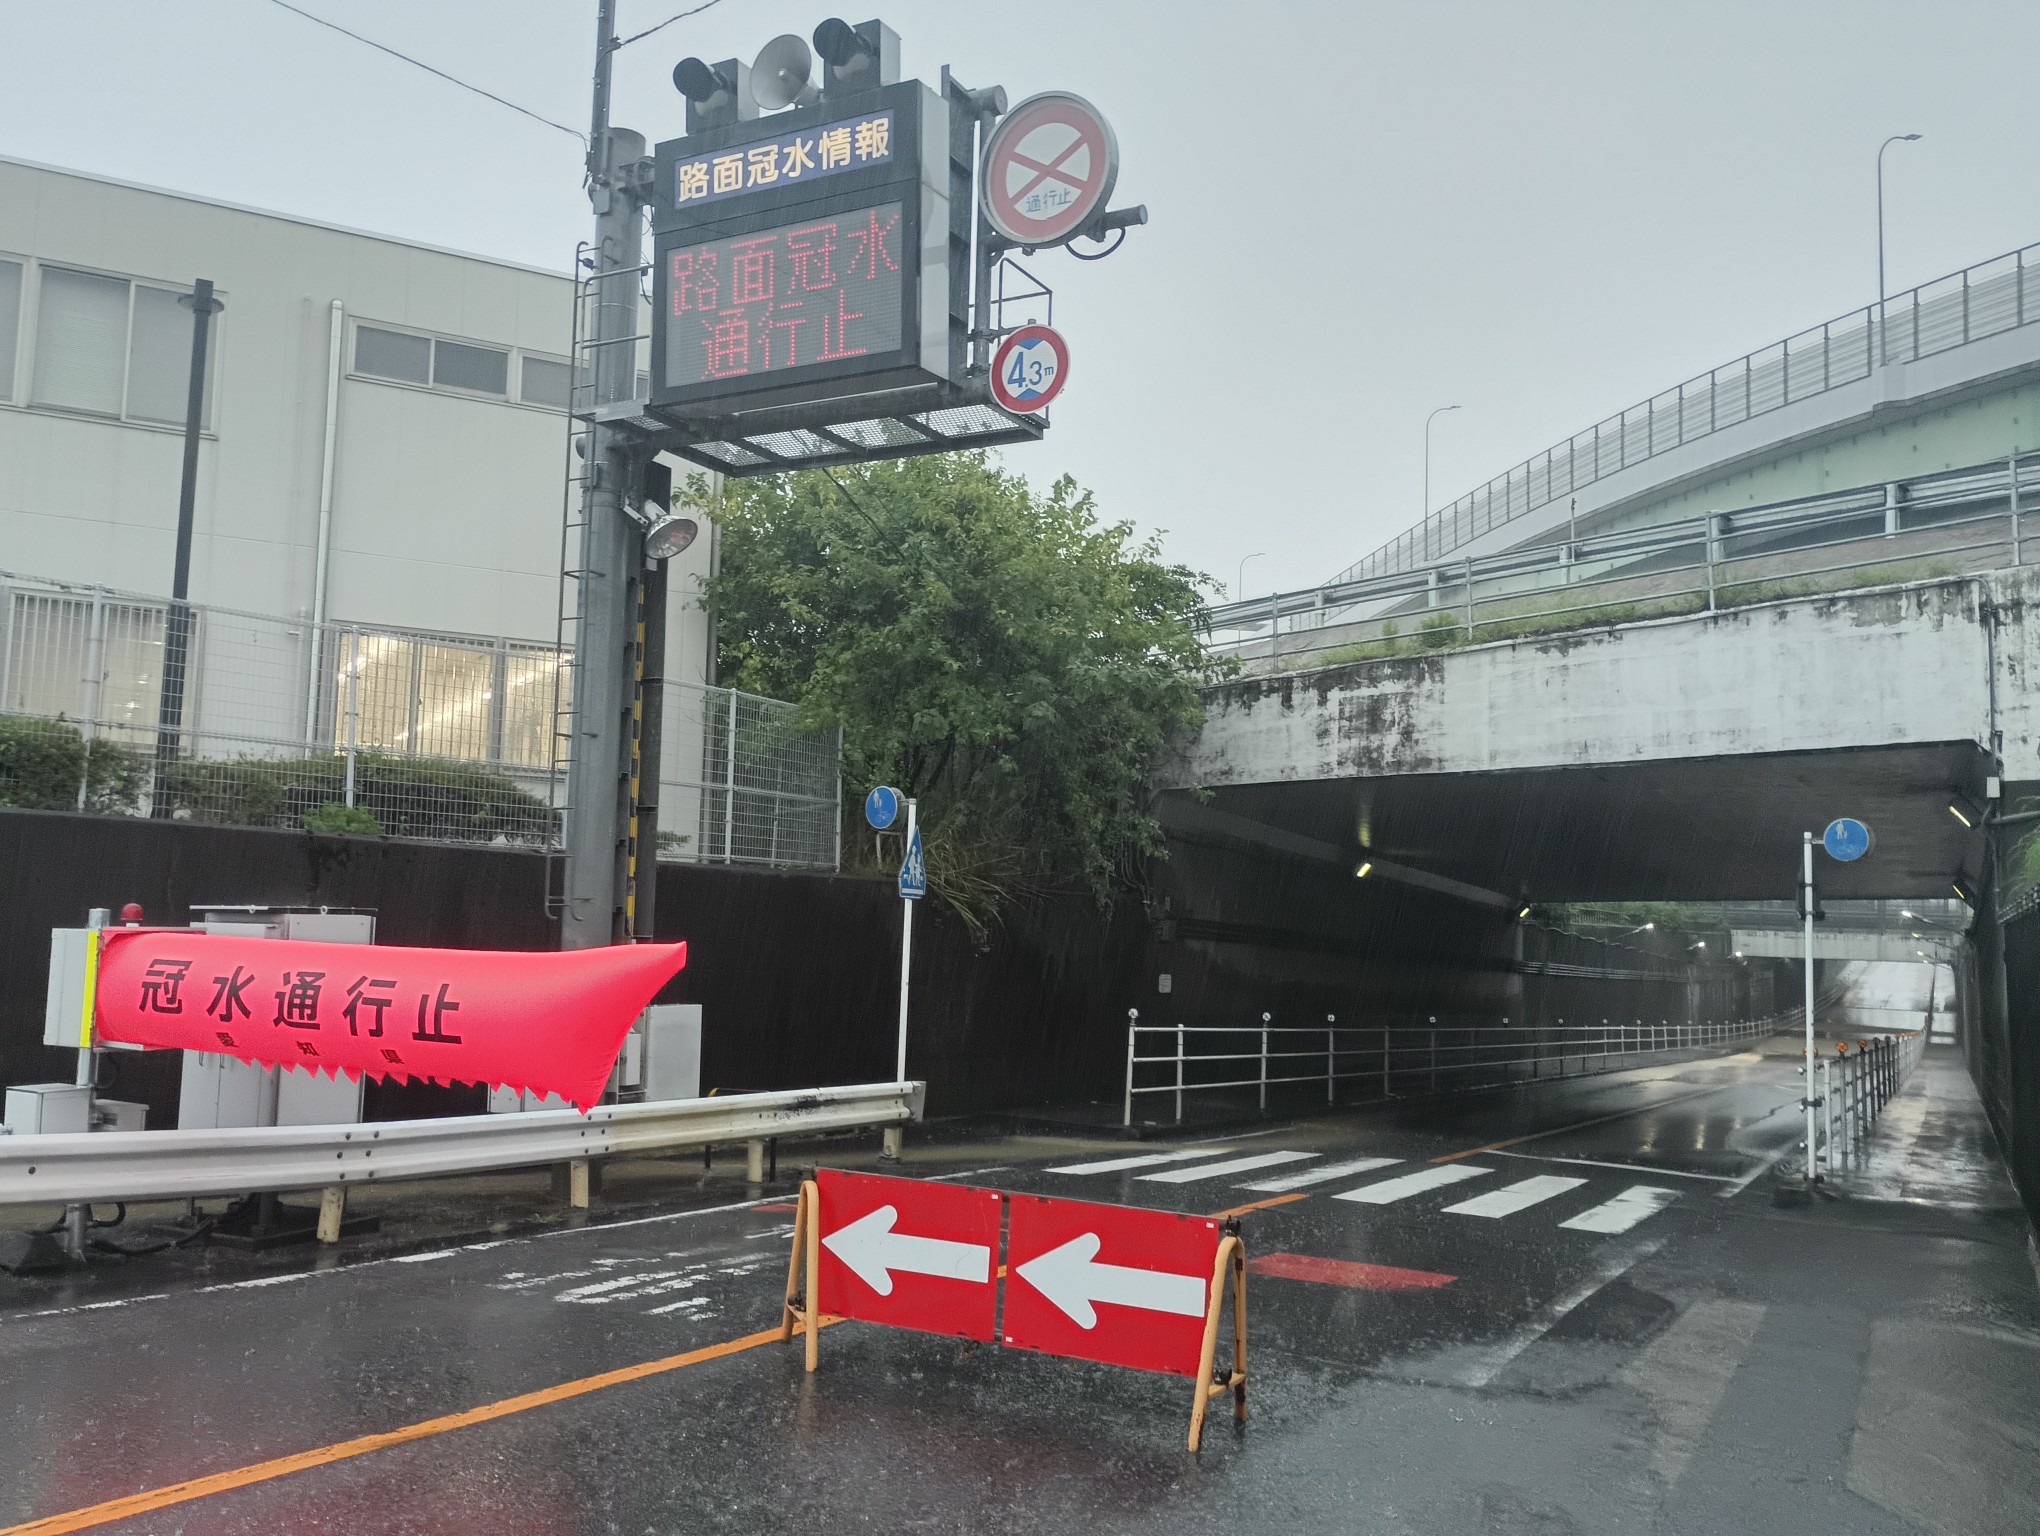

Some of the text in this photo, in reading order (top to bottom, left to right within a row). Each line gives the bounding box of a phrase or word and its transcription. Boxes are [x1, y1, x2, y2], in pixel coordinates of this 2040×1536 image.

[678, 117, 890, 202] 路面冠水情報
[1025, 187, 1072, 213] 通行止
[674, 208, 900, 316] 路面冠水
[700, 288, 868, 380] 通行止
[138, 958, 463, 1045] 冠水通行止
